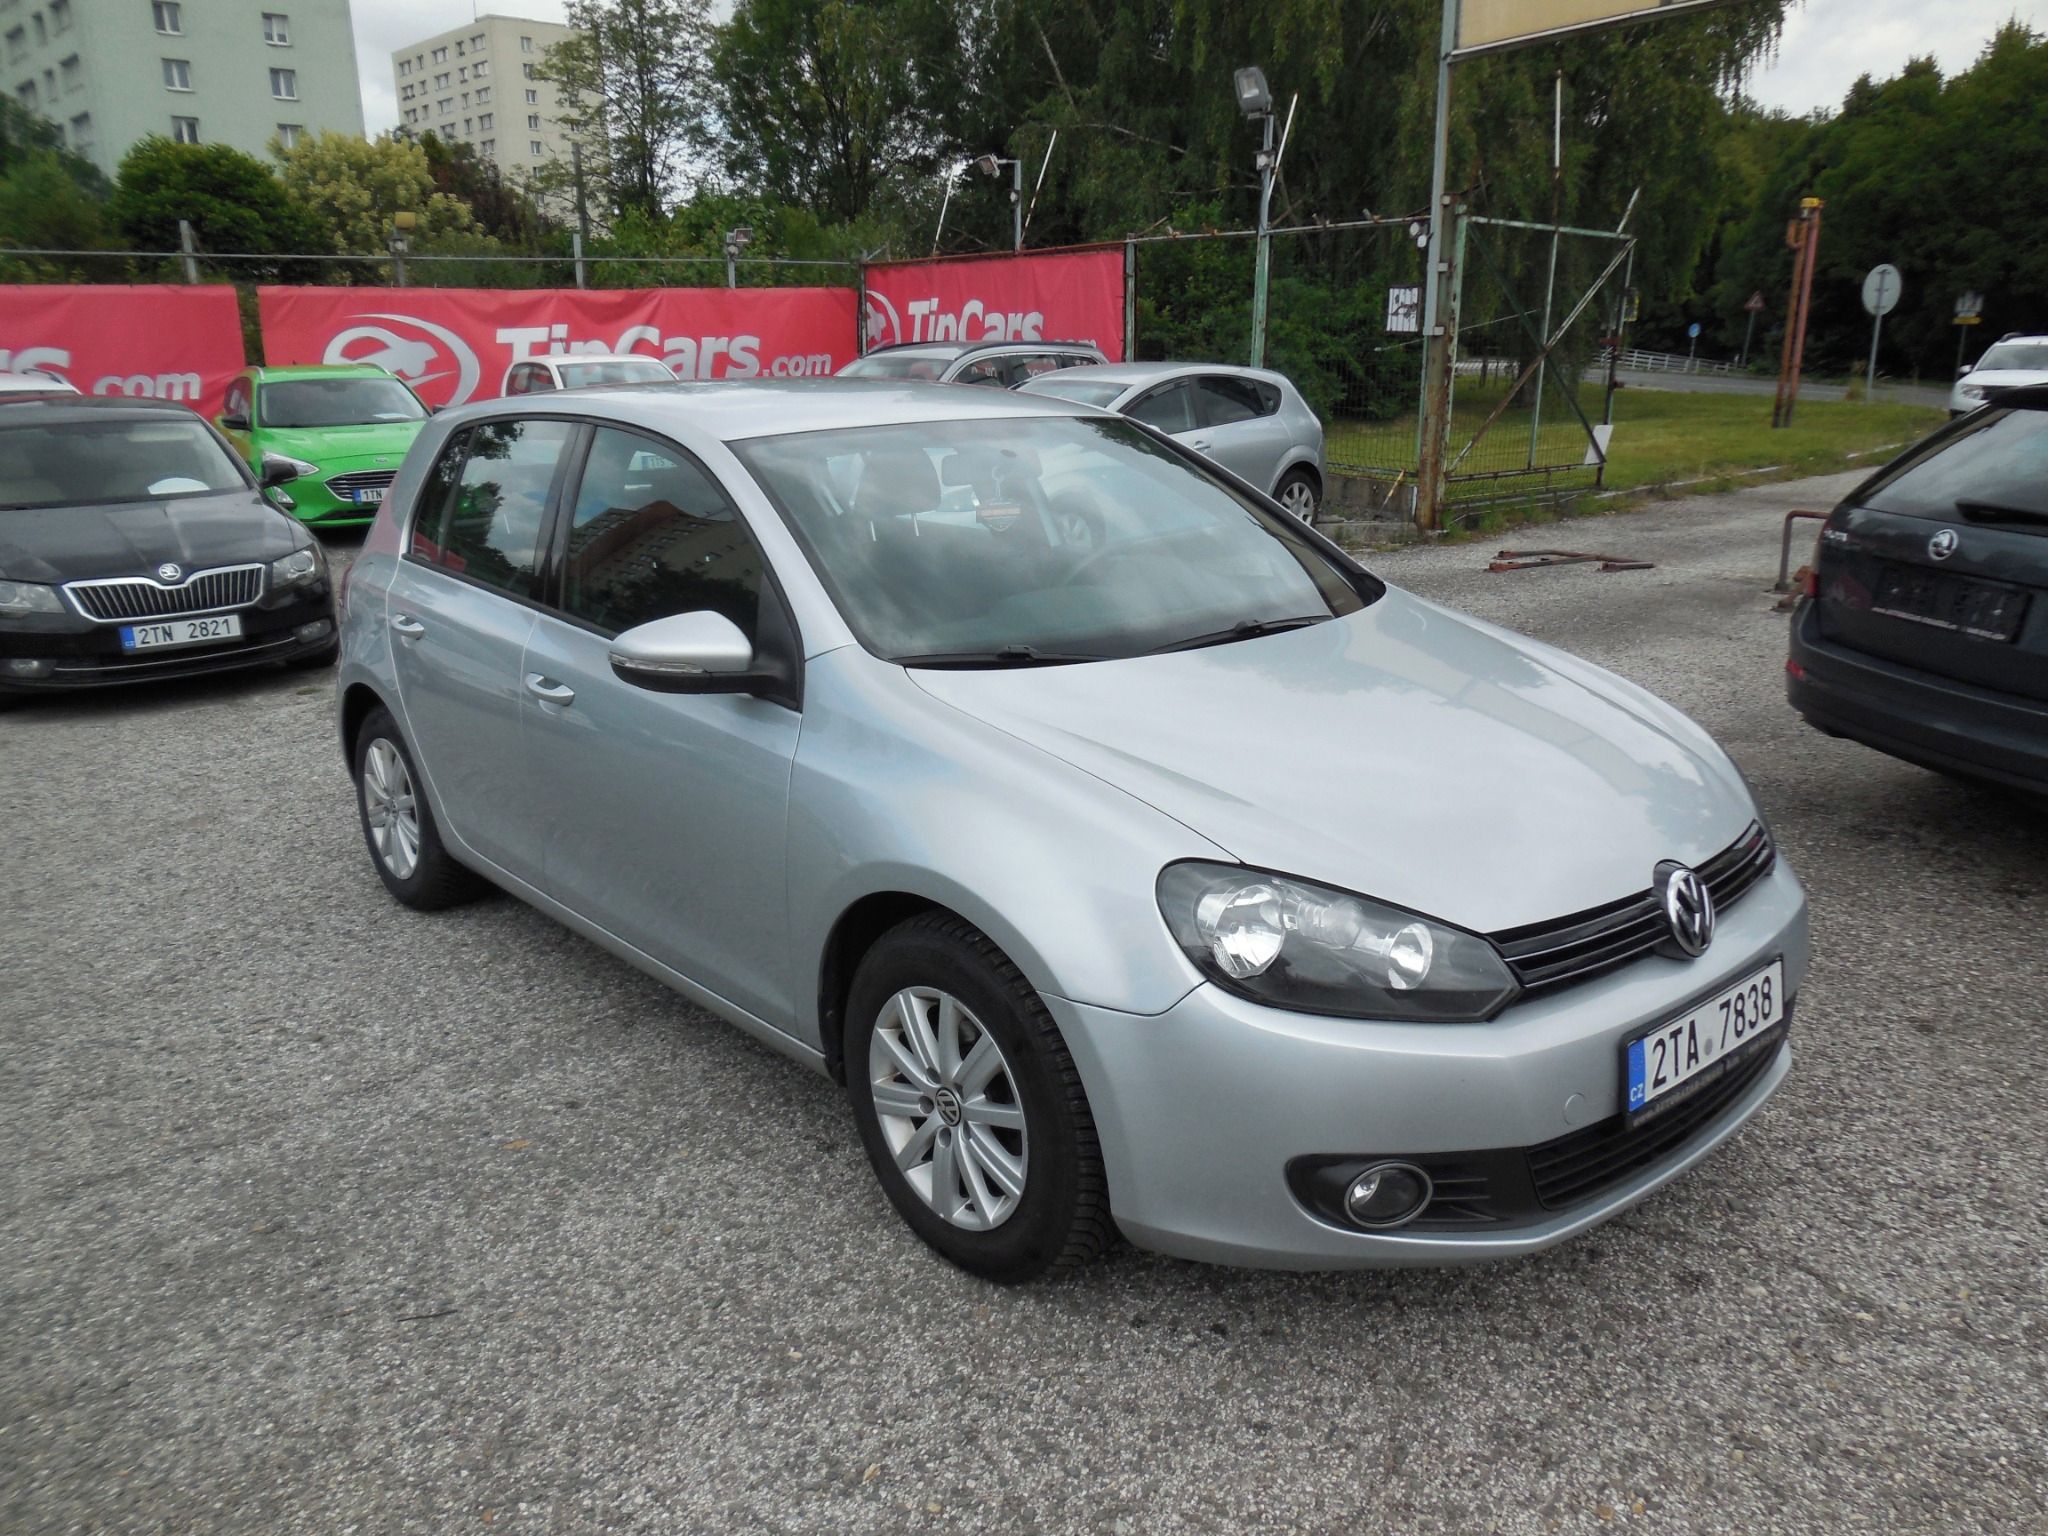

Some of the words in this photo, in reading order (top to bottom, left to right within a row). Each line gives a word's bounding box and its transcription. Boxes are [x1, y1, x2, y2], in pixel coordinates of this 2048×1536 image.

[908, 298, 1097, 347] TiCars
[139, 625, 173, 645] 2TN
[187, 618, 231, 639] 2821
[1652, 1019, 1699, 1090] 2TA
[1719, 975, 1772, 1050] 7838
[1630, 1082, 1644, 1102] CZ
